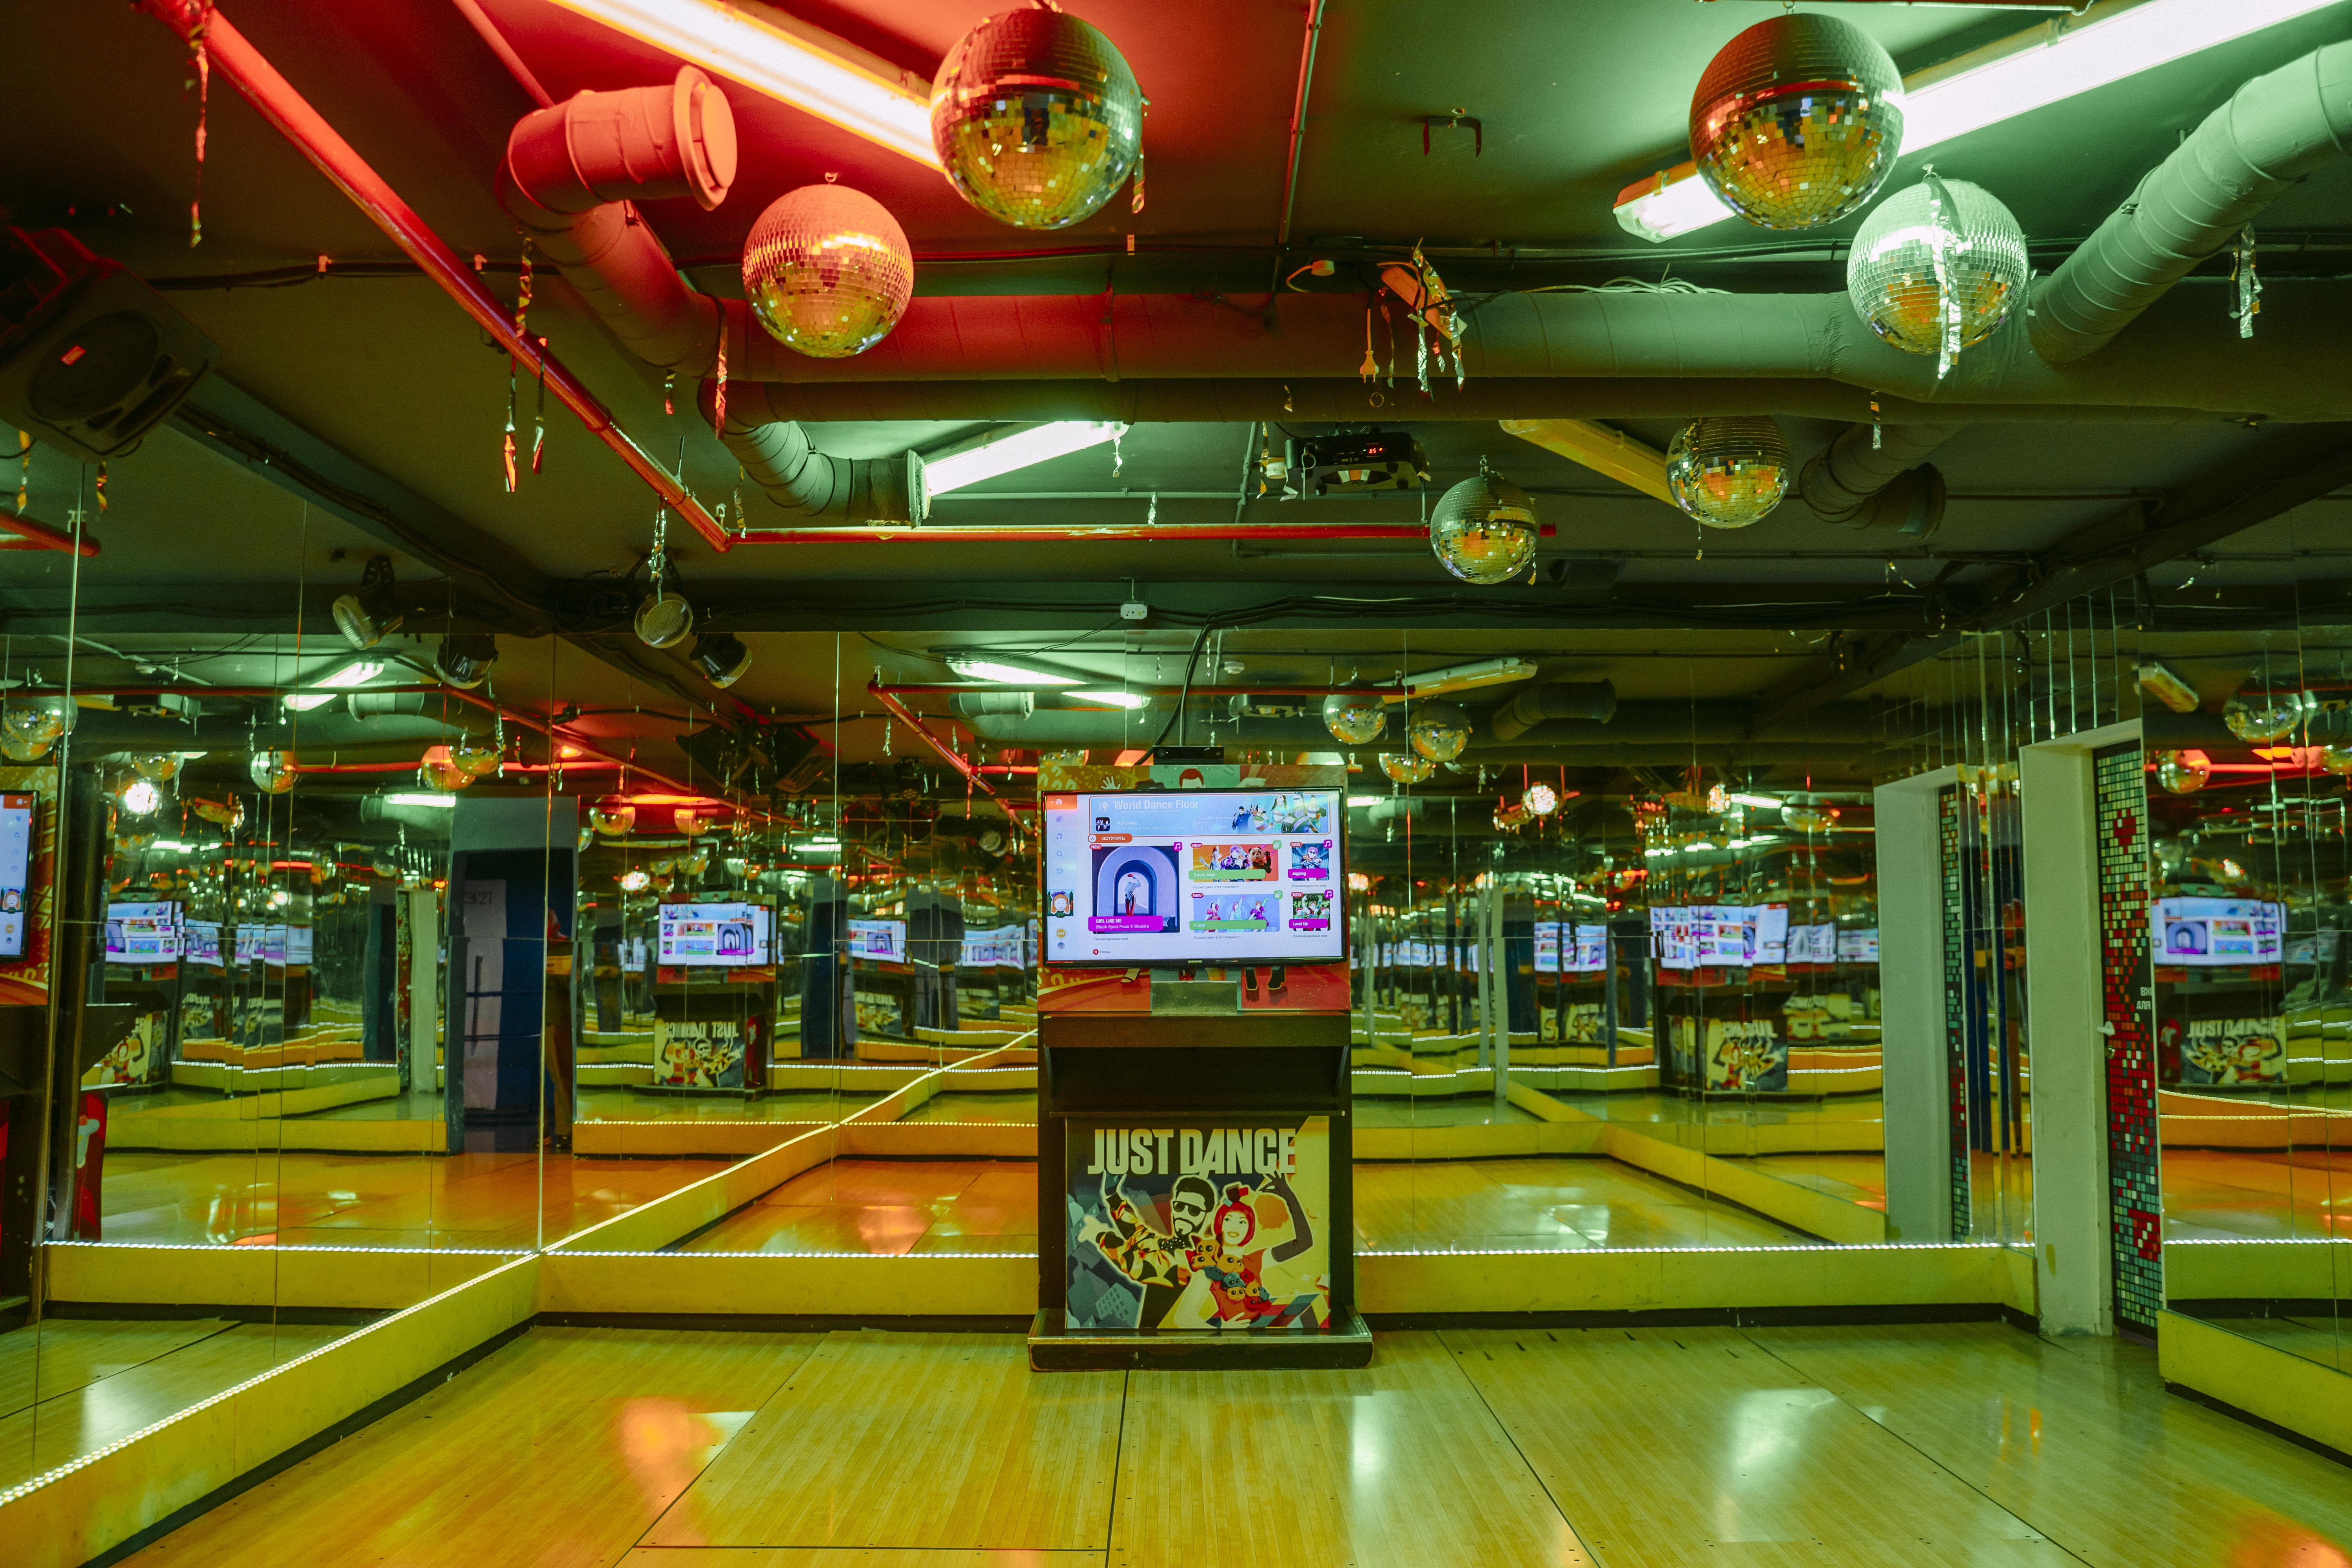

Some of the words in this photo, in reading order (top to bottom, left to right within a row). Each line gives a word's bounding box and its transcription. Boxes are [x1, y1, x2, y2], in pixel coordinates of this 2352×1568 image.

[1114, 800, 1141, 810] World
[1144, 800, 1173, 809] Dance
[1176, 799, 1199, 809] Floor
[1087, 1128, 1174, 1175] JUST
[1180, 1128, 1296, 1178] DANCE
